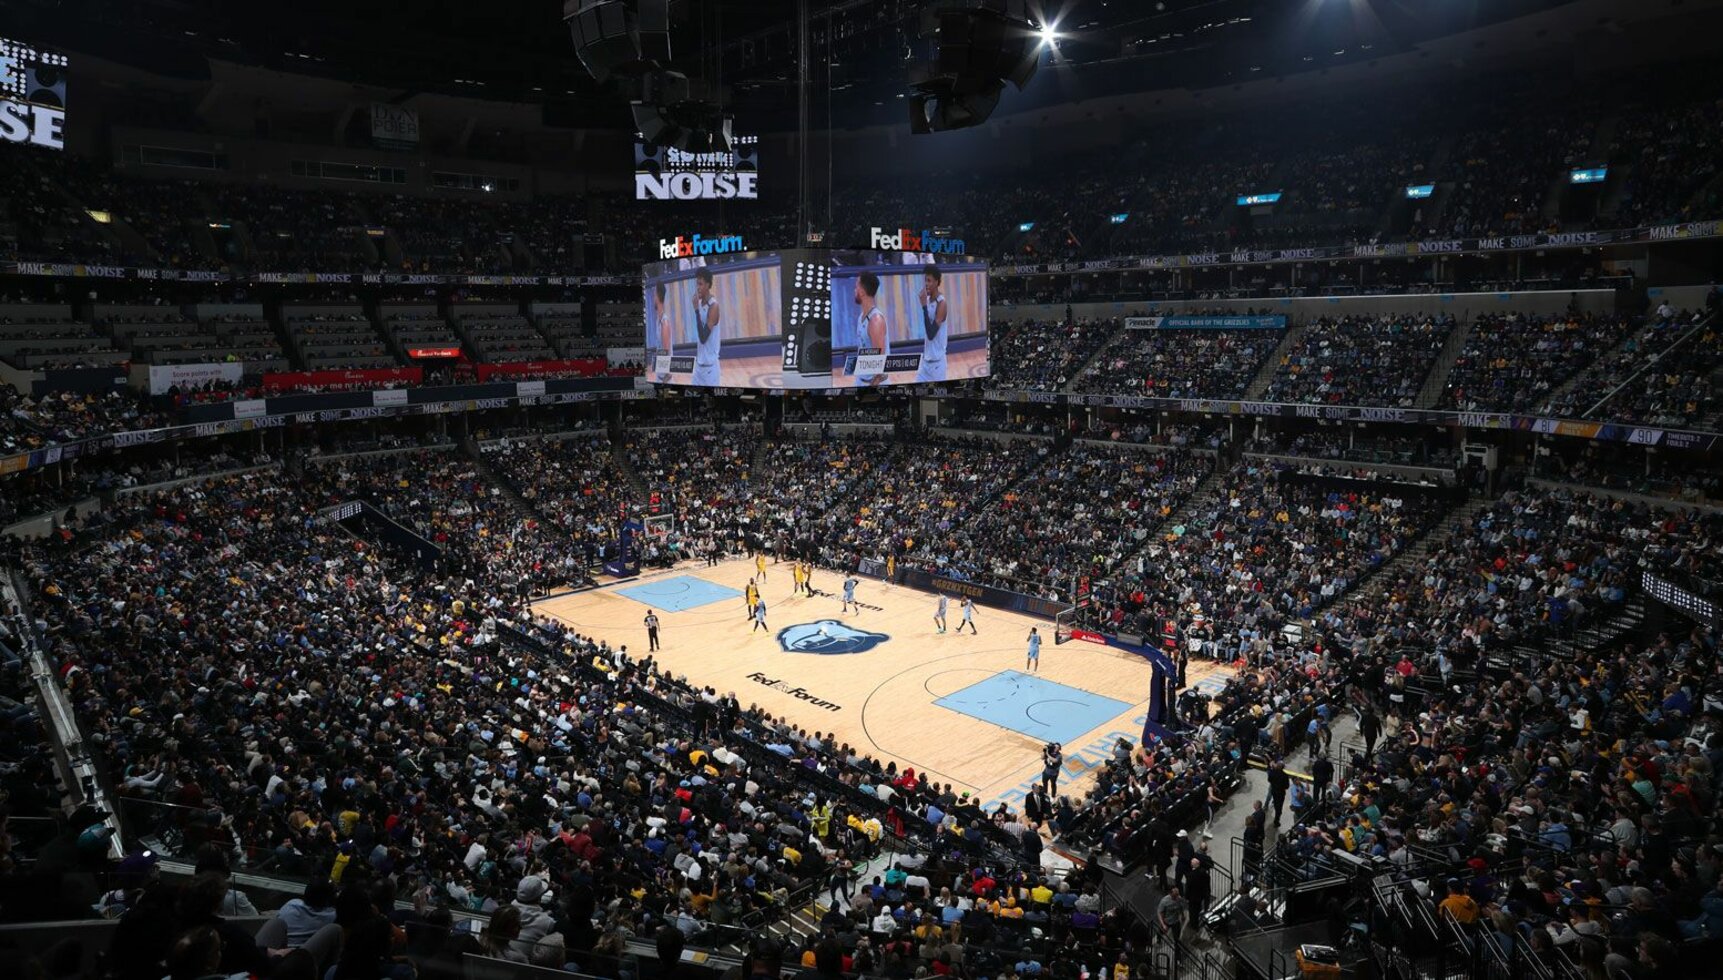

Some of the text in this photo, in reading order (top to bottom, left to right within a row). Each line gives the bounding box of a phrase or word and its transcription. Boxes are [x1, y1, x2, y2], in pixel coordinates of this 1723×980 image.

[635, 172, 758, 200] NOISE
[1649, 225, 1681, 240] MAKE
[660, 234, 743, 259] FedExForum
[870, 227, 965, 255] FedExForum
[1478, 232, 1599, 249] MAKE SOME NOISE
[1231, 252, 1250, 262] MAKE
[1280, 248, 1315, 260] NOISE
[1354, 245, 1379, 257] MAKE
[1418, 240, 1463, 253] NOISE
[1084, 260, 1112, 269] NOISE
[1140, 257, 1158, 266] MAKE
[1186, 254, 1220, 264] NOISE
[18, 262, 45, 275] MAKE
[85, 266, 126, 279] NOISE
[137, 269, 158, 279] MAKE
[186, 271, 219, 280] NOISE
[259, 272, 282, 283] MAKE
[315, 274, 352, 283] NOISE
[363, 274, 382, 283] MAKE
[409, 275, 438, 283] NOISE
[467, 276, 486, 285] MAKE
[511, 277, 539, 285] NOISE
[587, 277, 614, 285] NOISE
[859, 359, 883, 369] TONIGHT
[518, 397, 537, 406] MAKE
[561, 392, 590, 401] NOISE
[620, 391, 640, 400] MAKE
[1027, 393, 1057, 403] NOISE
[1067, 395, 1085, 404] MAKE
[1113, 397, 1144, 408] NOISE
[422, 403, 444, 414] MAKE
[475, 398, 509, 409] NOISE
[1180, 401, 1203, 412] MAKE
[1240, 404, 1281, 417] NOISE
[295, 411, 316, 424] MAKE
[350, 407, 386, 417] NOISE
[1296, 406, 1405, 421] MAKE SOME NOISE
[1458, 413, 1490, 427] MAKE
[195, 424, 218, 437] MAKE
[252, 416, 286, 429] NOISE
[113, 432, 153, 448] NOISE
[1638, 430, 1653, 443] 90
